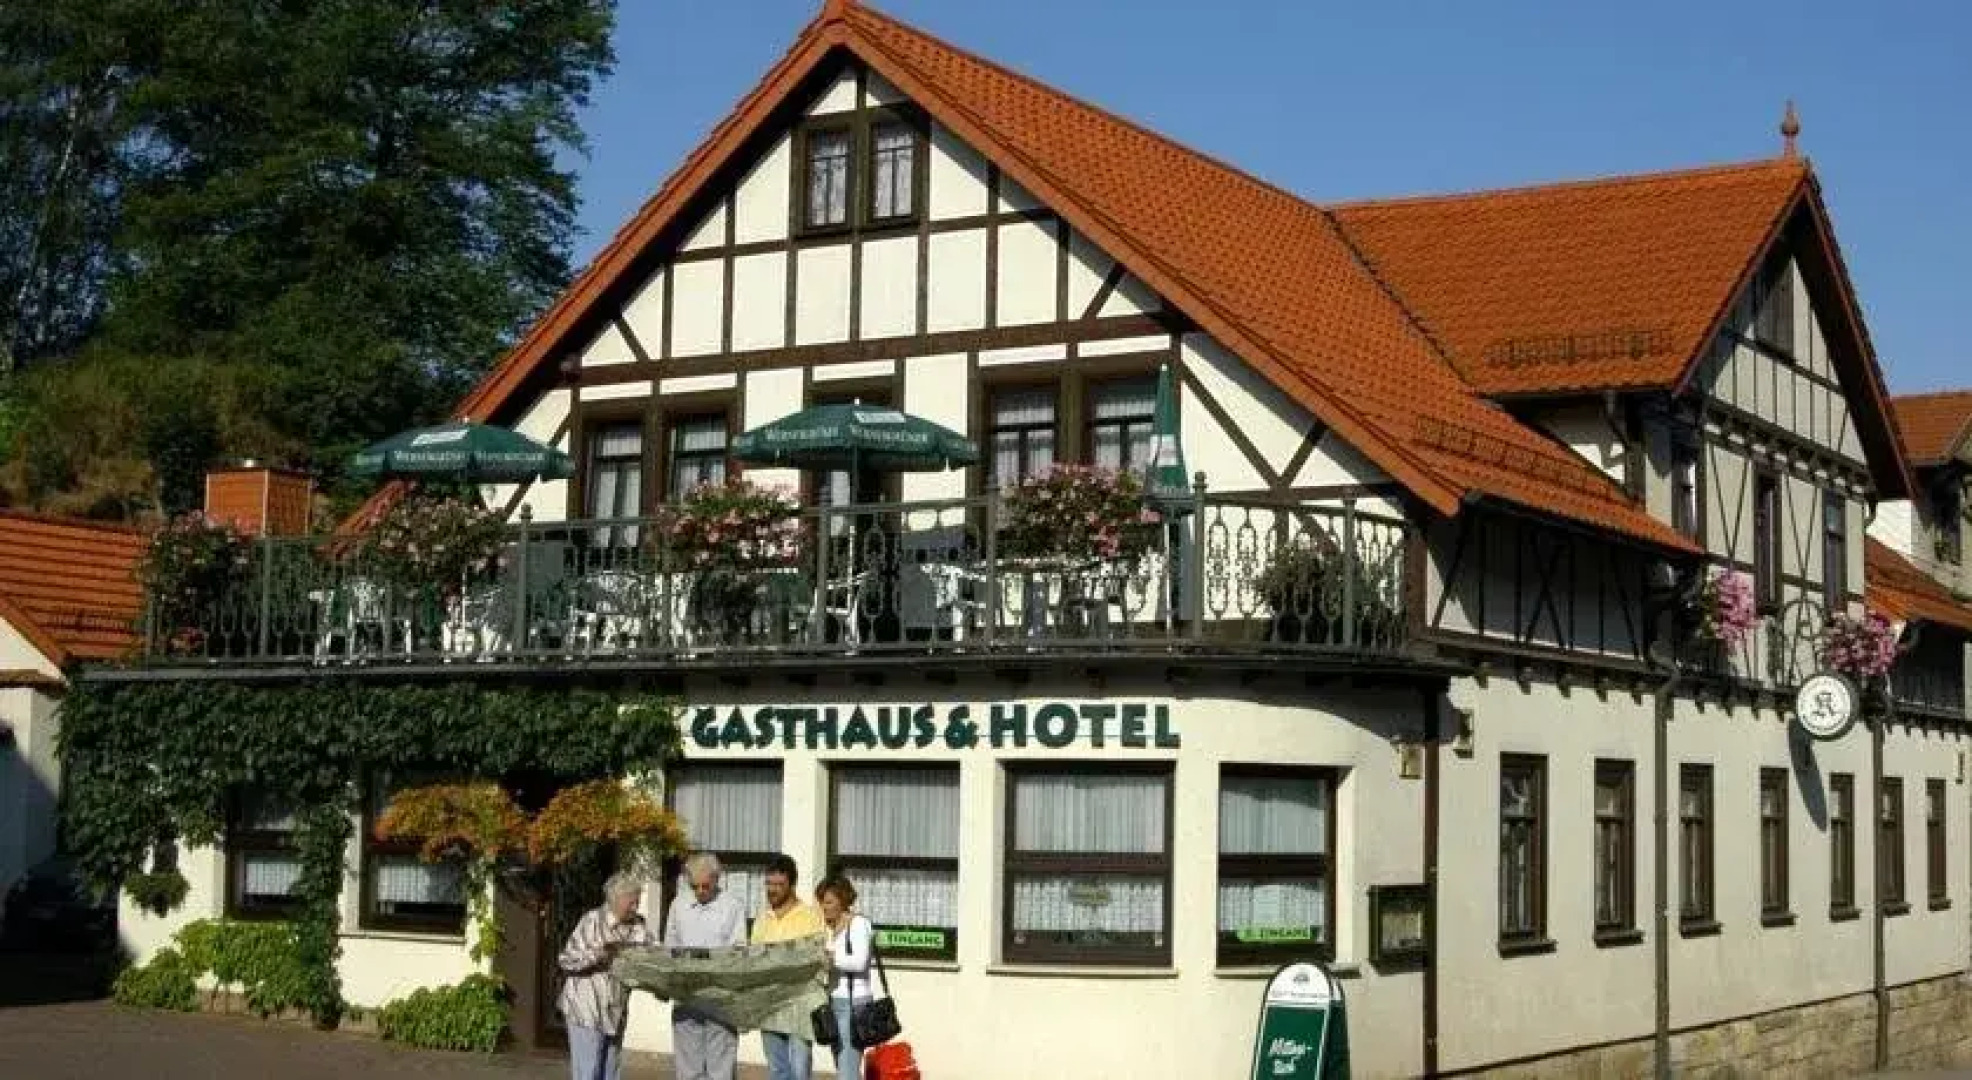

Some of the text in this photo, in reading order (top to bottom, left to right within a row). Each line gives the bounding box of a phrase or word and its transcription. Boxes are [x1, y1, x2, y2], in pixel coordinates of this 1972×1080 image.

[690, 702, 1181, 750] GASTHAUS & HOTEL
